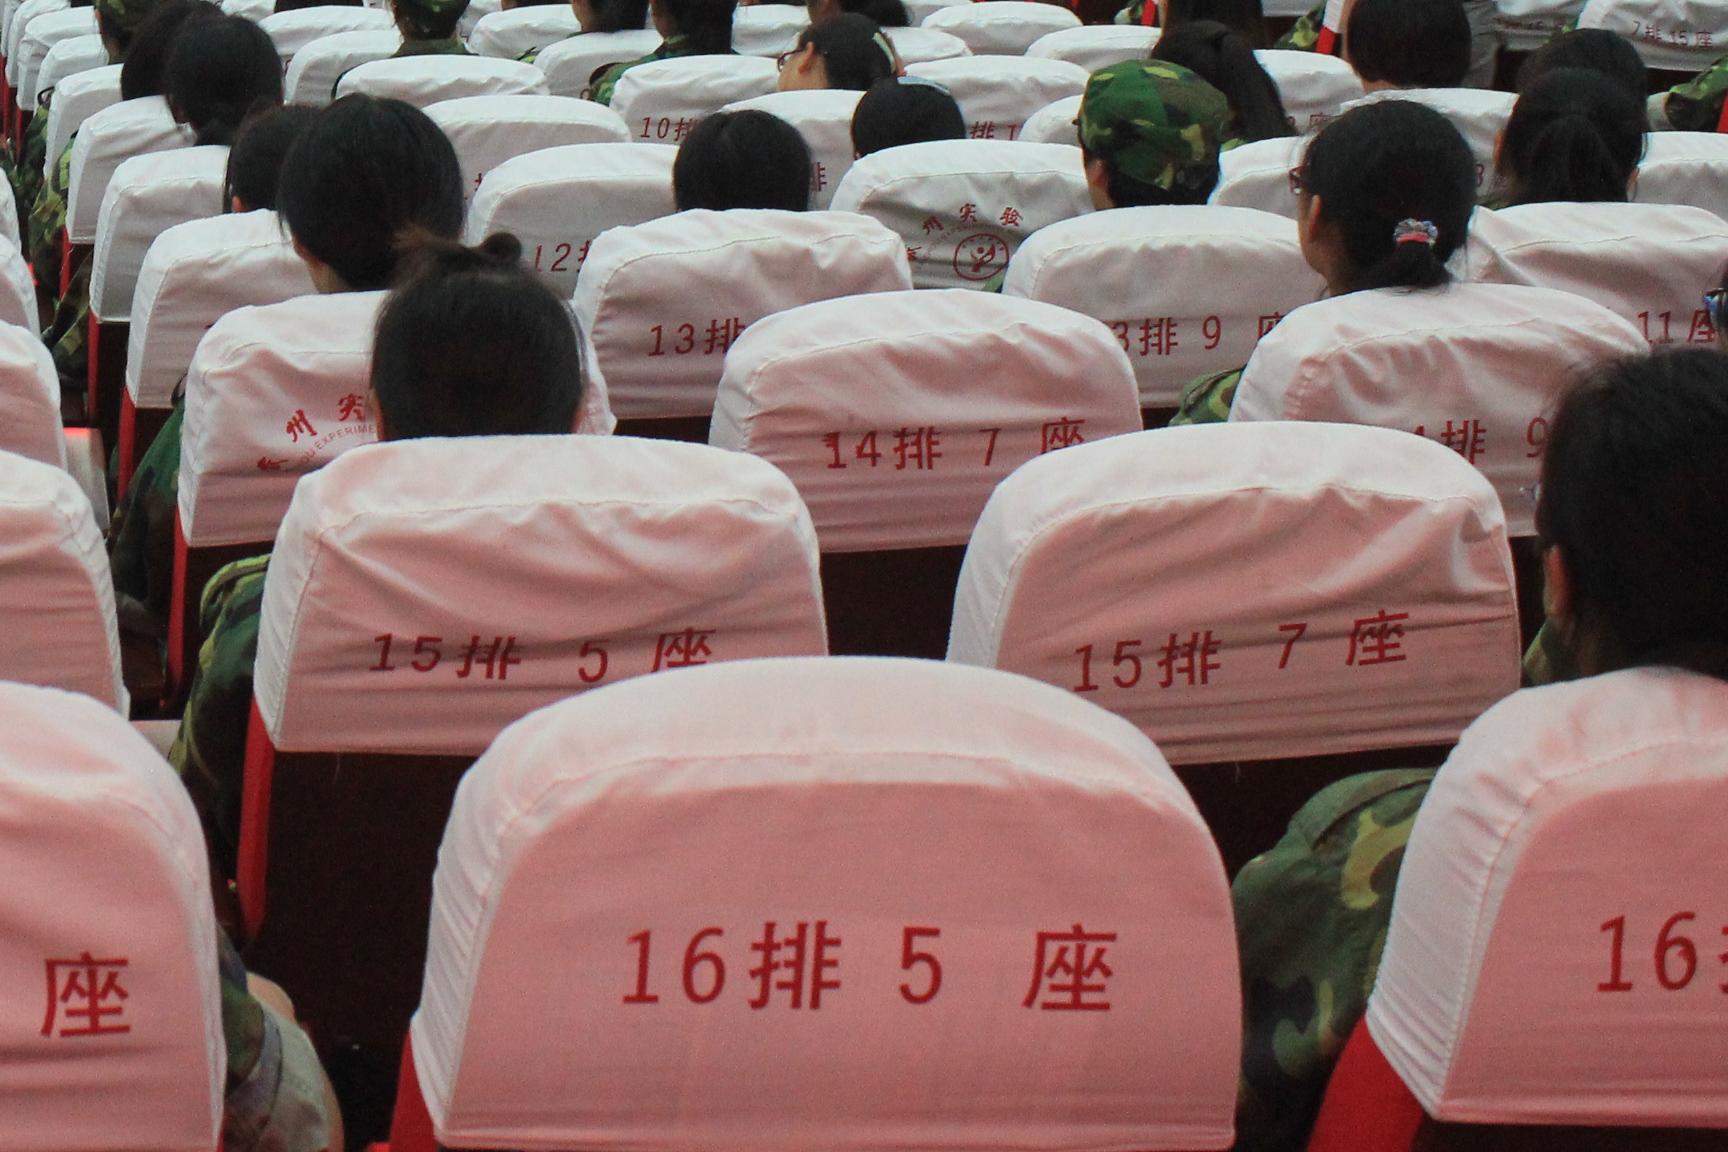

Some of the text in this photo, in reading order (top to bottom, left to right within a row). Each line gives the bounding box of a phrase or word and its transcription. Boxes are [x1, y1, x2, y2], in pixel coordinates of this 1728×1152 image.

[1073, 609, 1410, 693] 15排7座
[621, 920, 1119, 1013] 16排5座
[1596, 910, 1728, 995] 16
